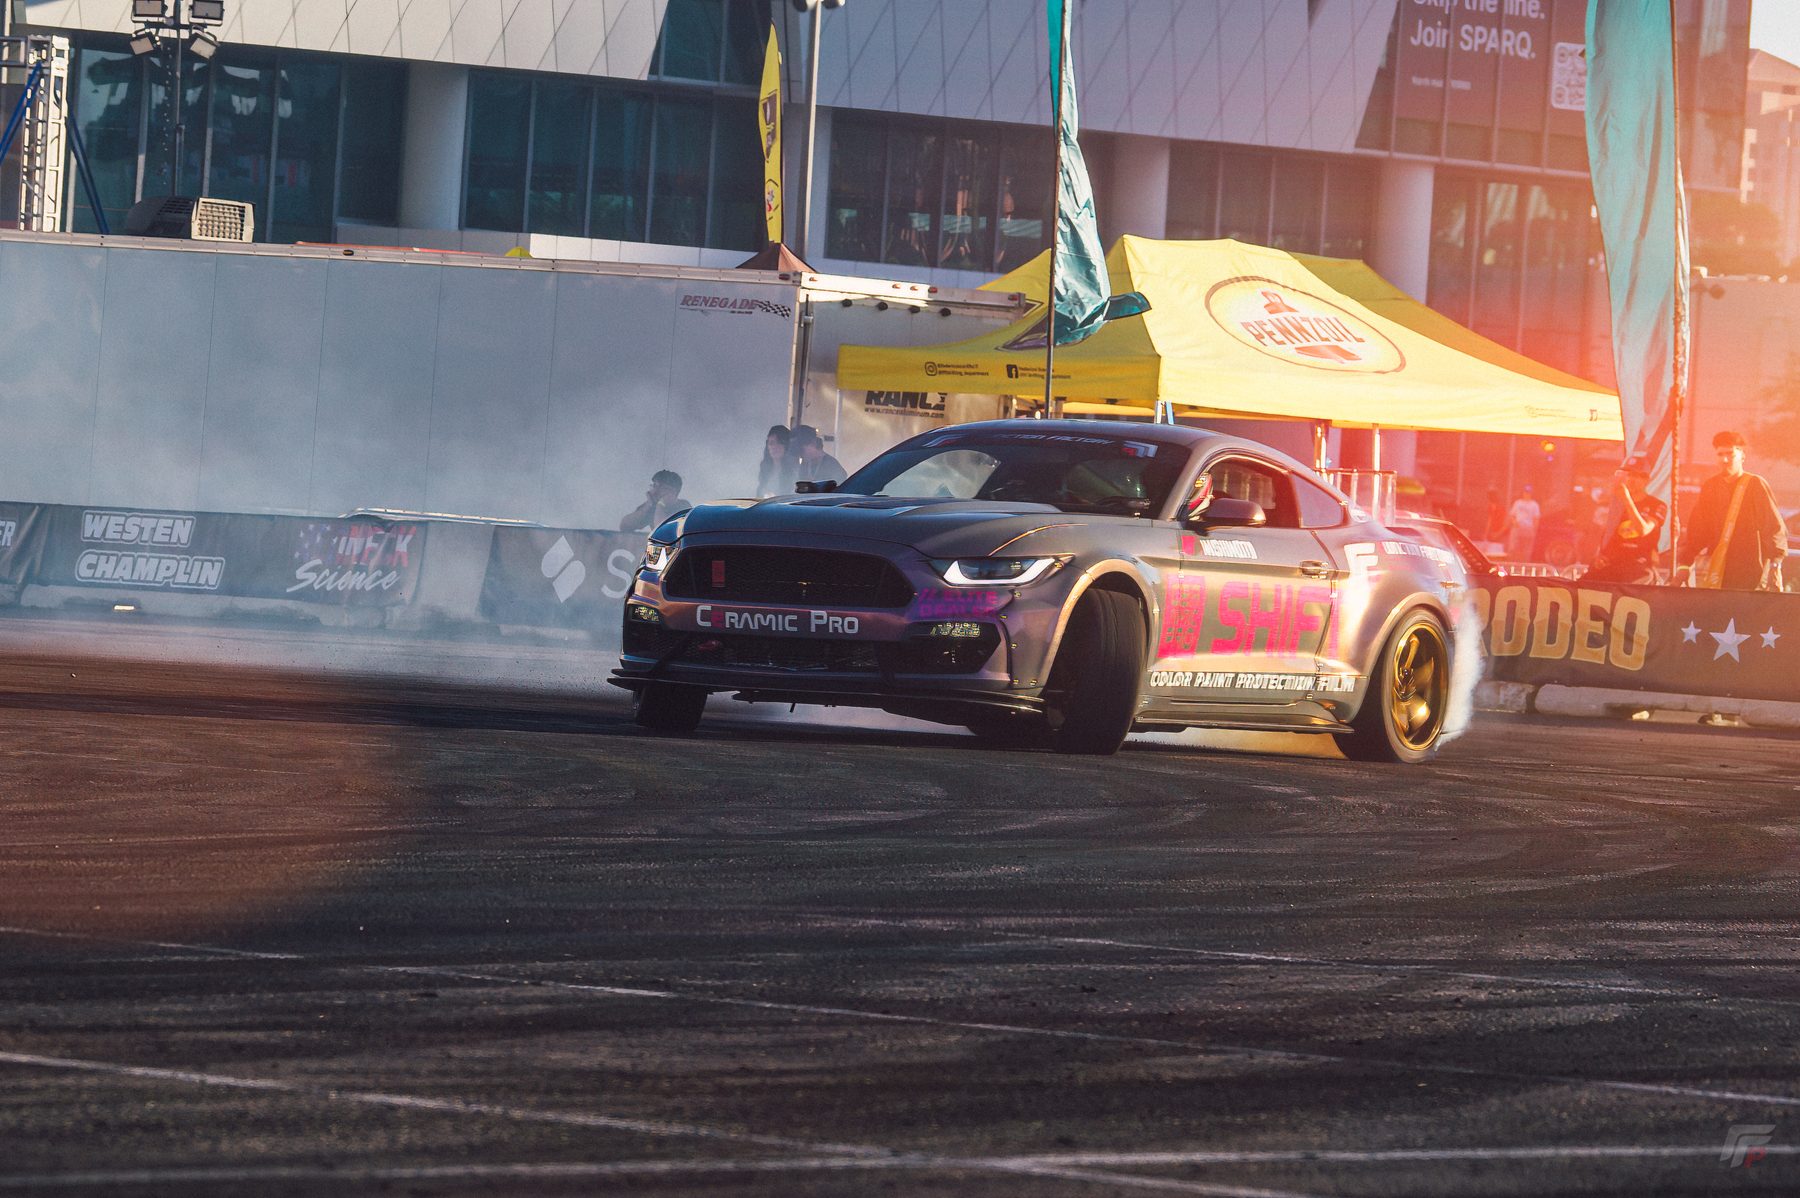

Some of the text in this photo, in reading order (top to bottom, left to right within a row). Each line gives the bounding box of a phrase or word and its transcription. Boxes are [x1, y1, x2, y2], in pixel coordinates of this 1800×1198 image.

[1459, 24, 1536, 60] SPARQ.
[680, 295, 757, 310] RENEGADE
[1240, 316, 1366, 347] PENNZOIL
[82, 511, 195, 547] WESTEN
[76, 550, 225, 589] CHAMPLIN
[286, 558, 401, 593] Science
[1150, 671, 1356, 692] COLOR PAINT PROTECTION FILM
